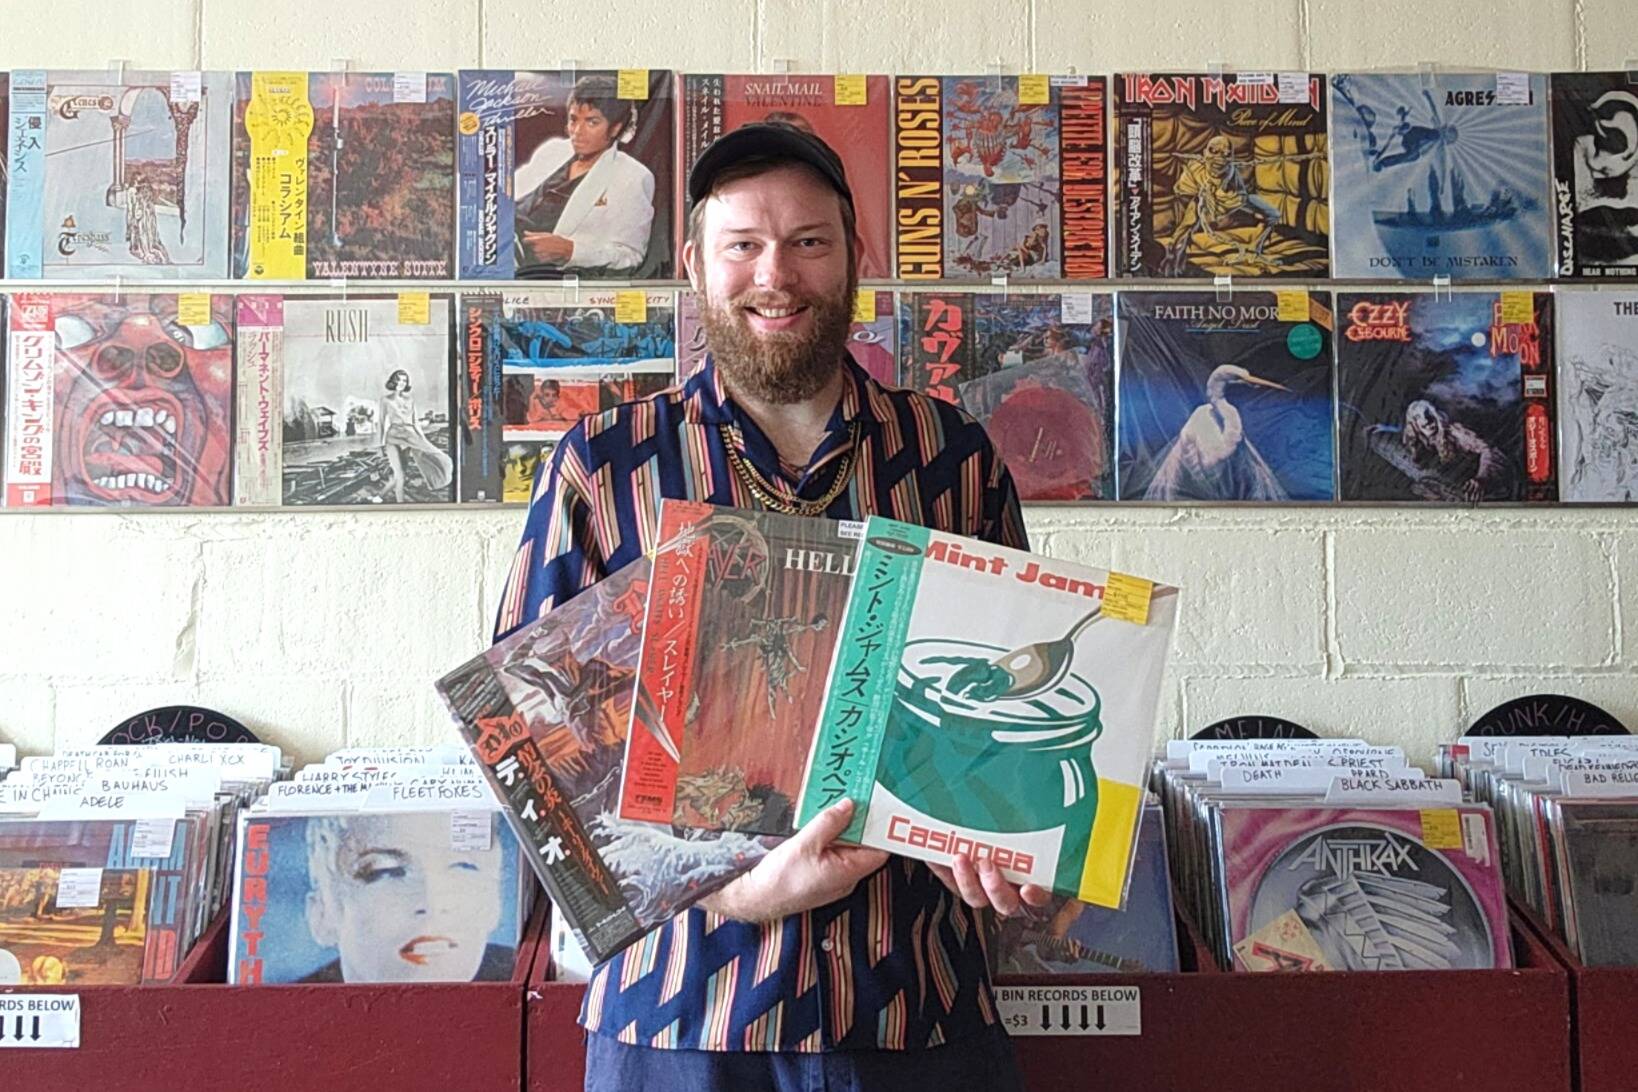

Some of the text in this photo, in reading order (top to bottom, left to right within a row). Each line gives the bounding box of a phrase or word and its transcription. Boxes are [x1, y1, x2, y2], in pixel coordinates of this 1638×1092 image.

[744, 82, 785, 96] SNAIL
[787, 82, 824, 96] MAIL
[1122, 74, 1196, 112] IRON
[1202, 75, 1321, 113] MAIDN
[744, 95, 824, 108] VALENTINE
[1227, 109, 1258, 128] Piece
[1270, 108, 1313, 128] Mind
[898, 77, 942, 281] GUNS N' ROSES
[279, 173, 293, 240] コラシアム
[312, 260, 448, 277] VALENTYNE SUITE
[1369, 255, 1519, 268] DON'T BE MISTAKEN
[1154, 305, 1204, 320] FAITH
[1208, 305, 1236, 320] NO
[1239, 305, 1279, 320] MOR
[1346, 301, 1412, 327] OZZY
[1613, 301, 1638, 316] THE
[325, 309, 369, 343] RUSH
[1345, 323, 1413, 342] OSBOURNE
[784, 547, 857, 577] HELL
[925, 539, 1009, 576] Mint
[1015, 561, 1106, 601] Jam
[95, 757, 129, 769] ROAN
[168, 753, 246, 766] CHARLI XCX
[1243, 769, 1282, 783] DEATH
[1584, 773, 1607, 784] BAD
[101, 780, 169, 792] BAUHAUS
[278, 783, 333, 795] FLORENCE
[342, 783, 359, 794] THE
[1341, 778, 1443, 791] BLACK SABBATH
[13, 789, 28, 802] IN
[393, 785, 484, 800] FLEET FOXES
[79, 796, 126, 809] ADELE
[1288, 832, 1420, 881] ANTHRAX
[1001, 989, 1138, 1002] BIN RECORDS BELOW
[27, 999, 76, 1012] BELOW
[1004, 1014, 1029, 1028] =$3
